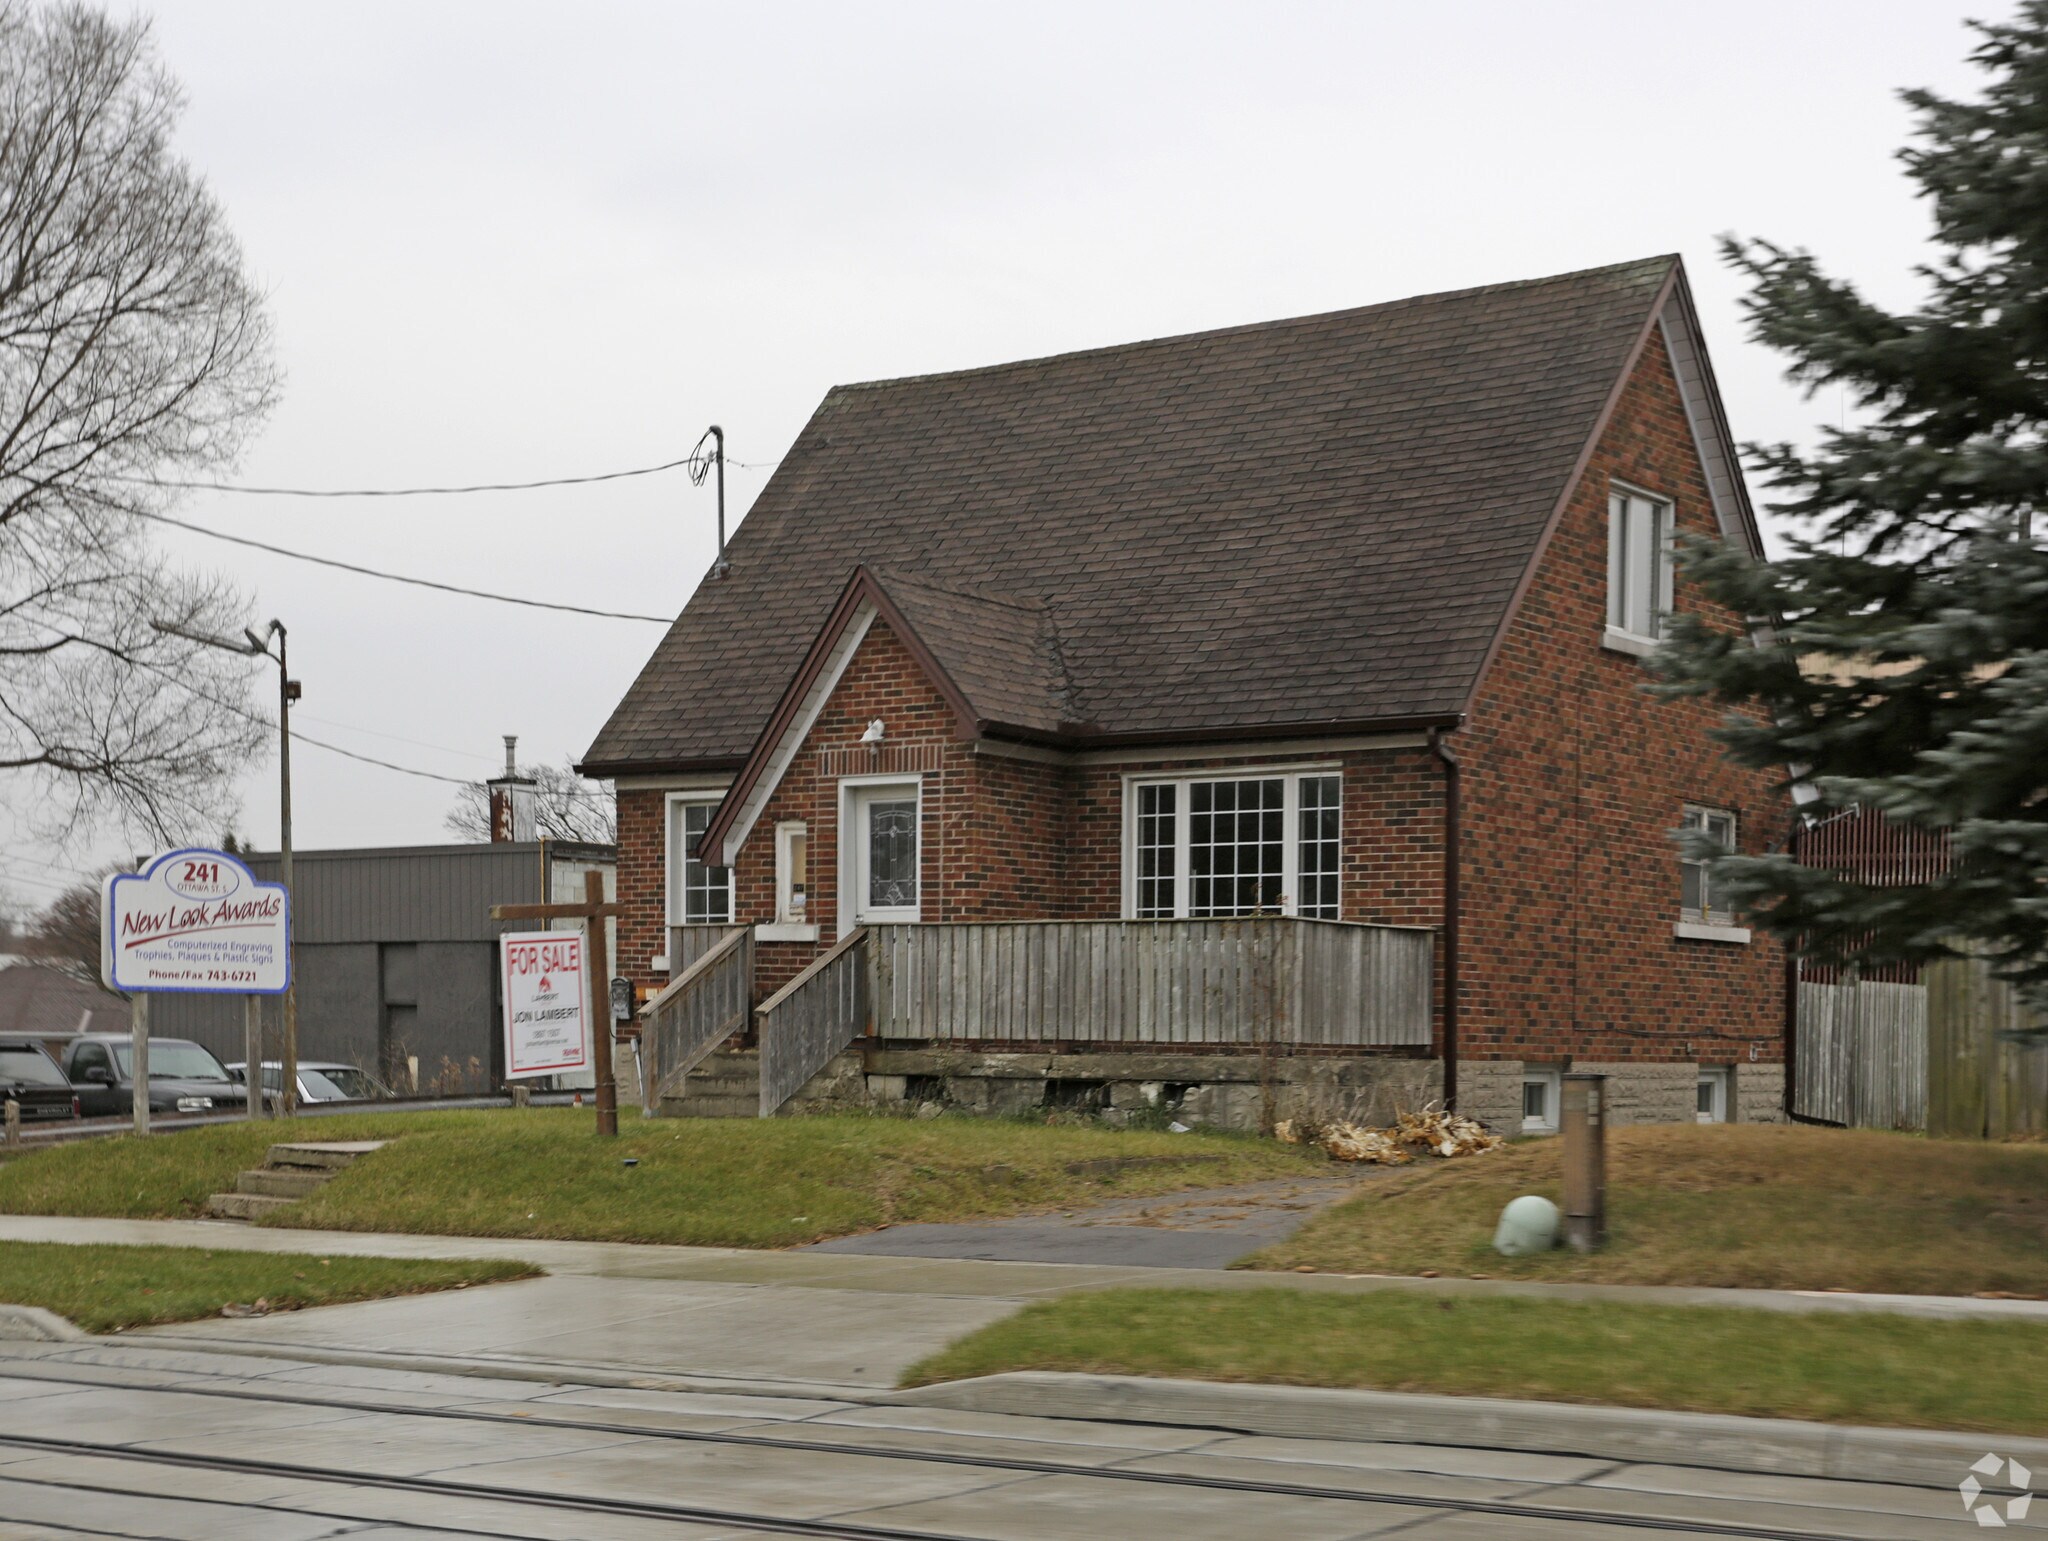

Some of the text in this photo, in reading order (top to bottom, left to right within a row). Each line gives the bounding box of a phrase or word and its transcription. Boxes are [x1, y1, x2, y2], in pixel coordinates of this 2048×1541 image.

[184, 862, 219, 883] 241
[177, 883, 209, 892] OTTAWA
[122, 894, 281, 937] New Look Awards
[168, 939, 273, 954] Computerized Engraving
[135, 950, 273, 966] Trophies, Plaques & Plastic Signs
[508, 944, 578, 976] FOR SALE
[149, 970, 203, 981] Phone/Fax
[513, 1007, 579, 1023] JON LAMBERT
